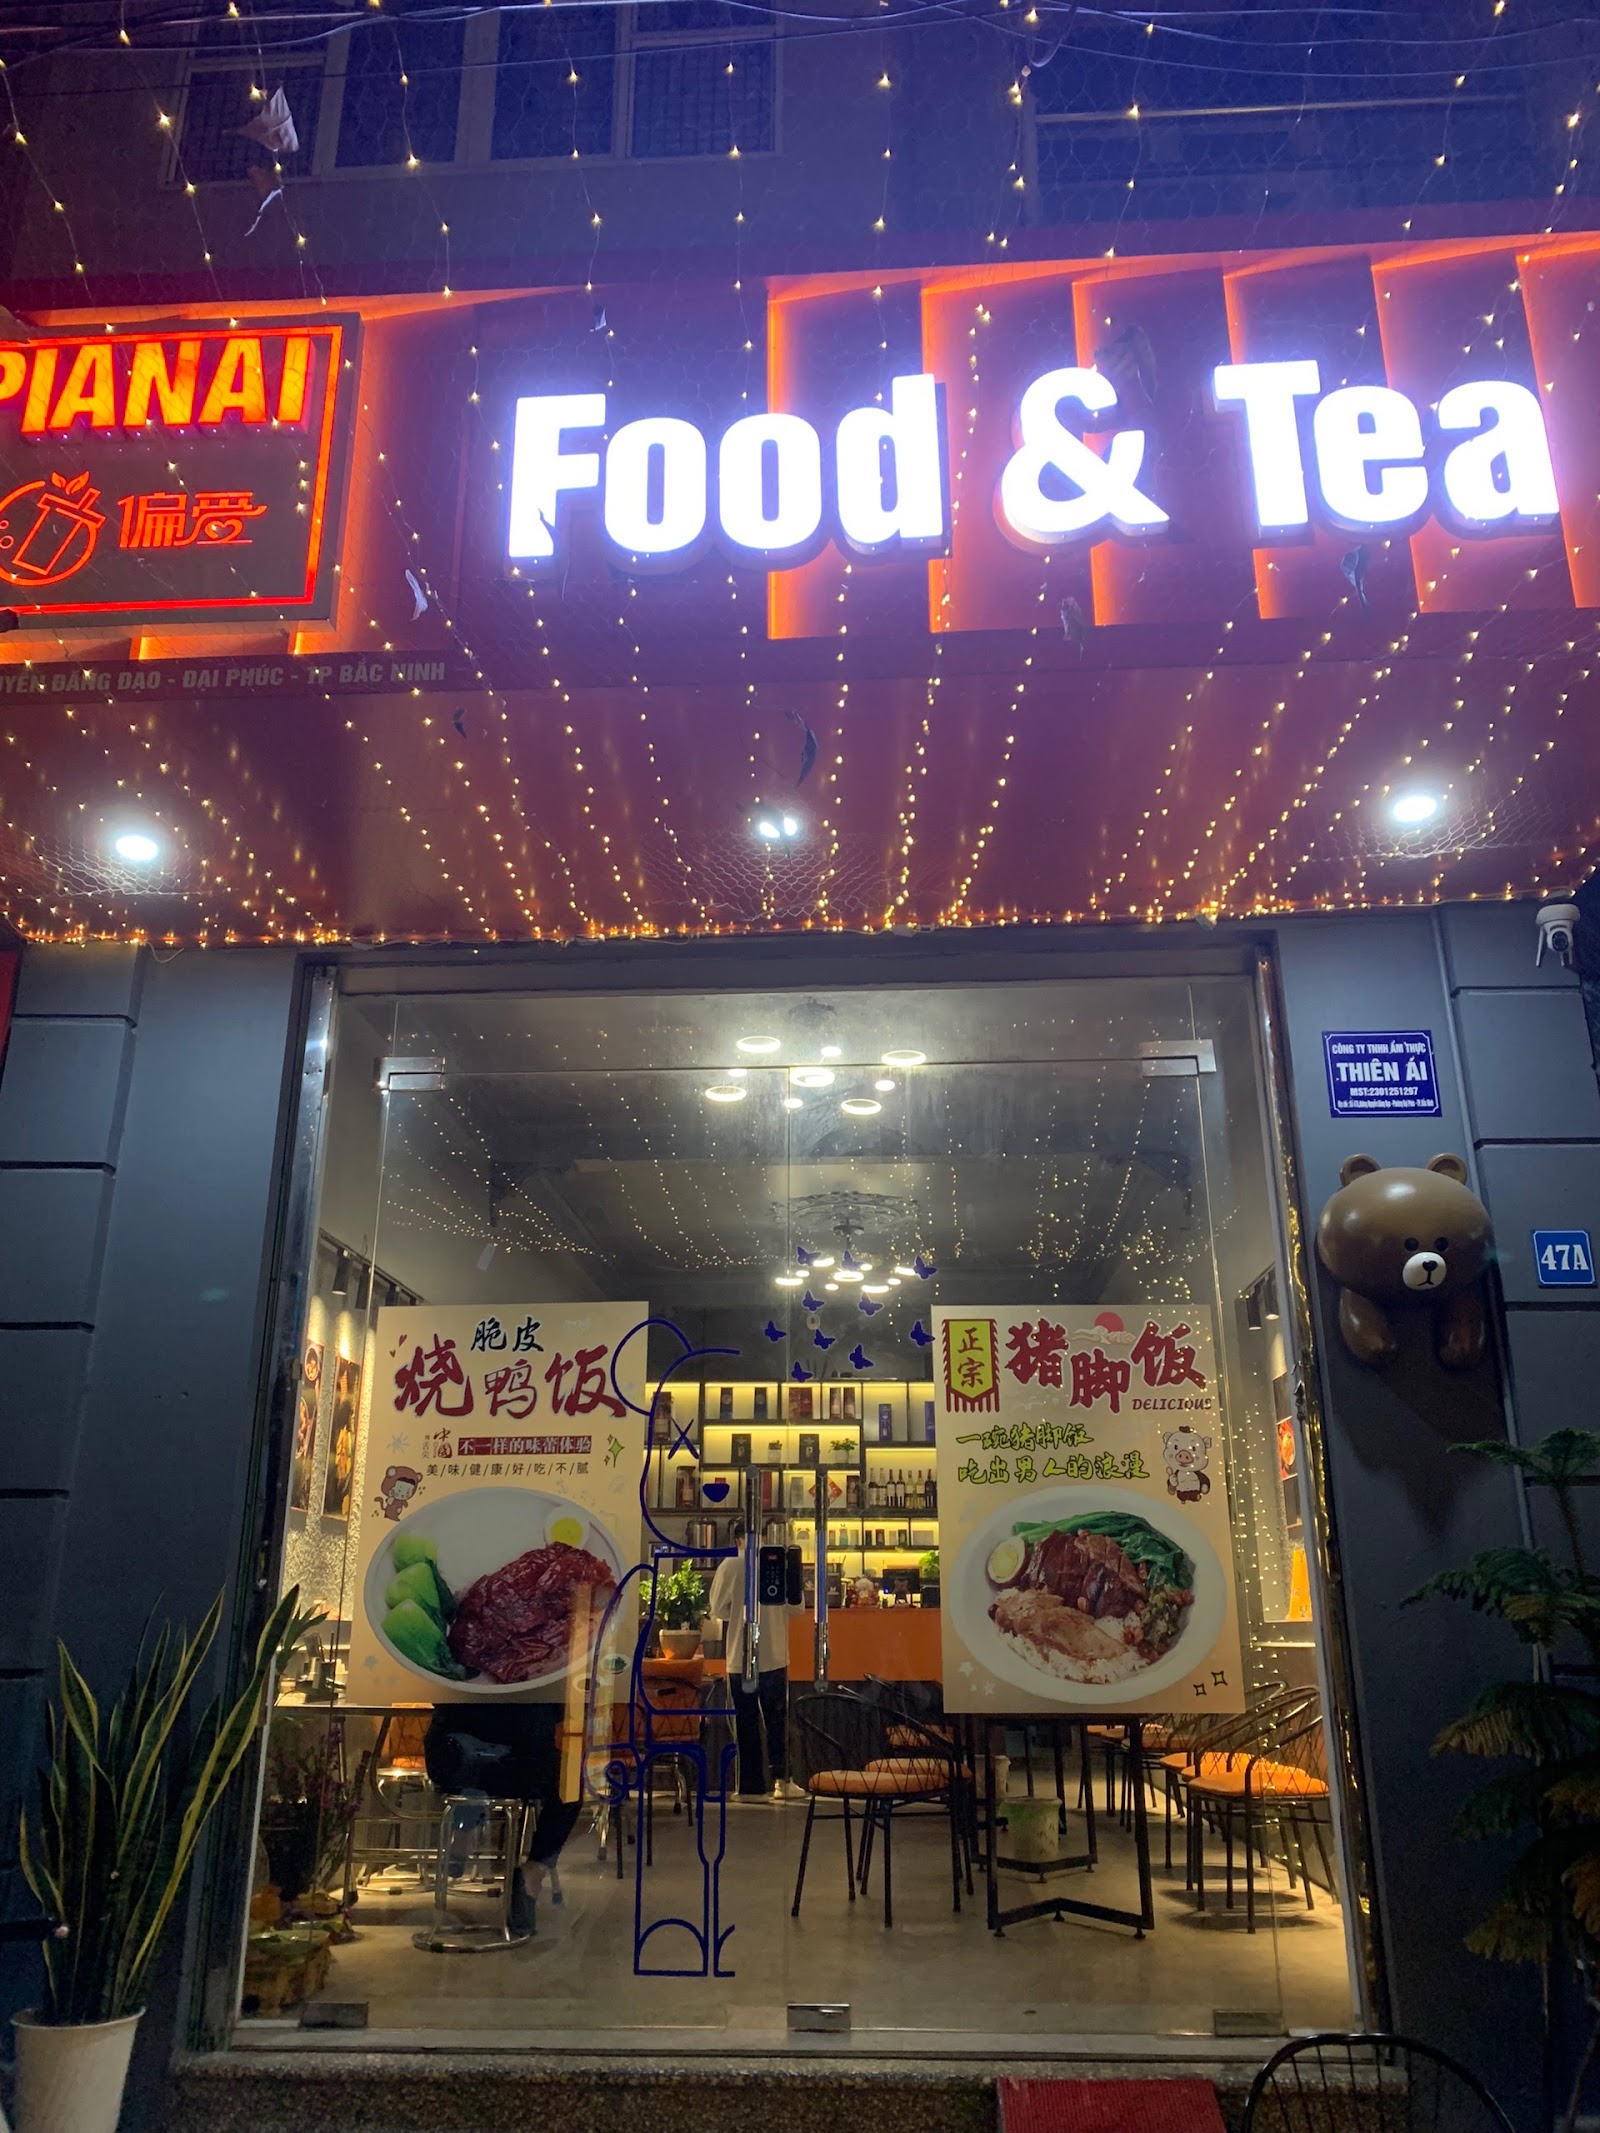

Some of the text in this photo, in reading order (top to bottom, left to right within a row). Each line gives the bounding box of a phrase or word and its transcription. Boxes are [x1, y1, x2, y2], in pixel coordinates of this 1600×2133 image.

[508, 359, 1560, 558] Food & Tea
[118, 671, 161, 694] ĐẠO
[182, 669, 218, 692] ĐẠI
[225, 664, 284, 687] PHÚC
[307, 666, 333, 685] TP
[339, 657, 383, 684] BẮC
[391, 662, 445, 682] NINH
[1332, 1042, 1354, 1054] CÔNG
[1355, 1044, 1365, 1054] TY
[1367, 1044, 1389, 1054] TNHH
[1336, 1058, 1400, 1082] THIÊN
[1540, 1244, 1589, 1271] 47A
[469, 1316, 545, 1353] 脆皮
[956, 1326, 986, 1389] 正宗
[1004, 1318, 1208, 1414] 猪脚饭
[393, 1332, 628, 1420] 烧鸭饭
[1131, 1397, 1213, 1412] DELICIOUS
[459, 1436, 591, 1455] 不一样的味蕾体验
[957, 1450, 1151, 1485] 吃出男人的浪漫
